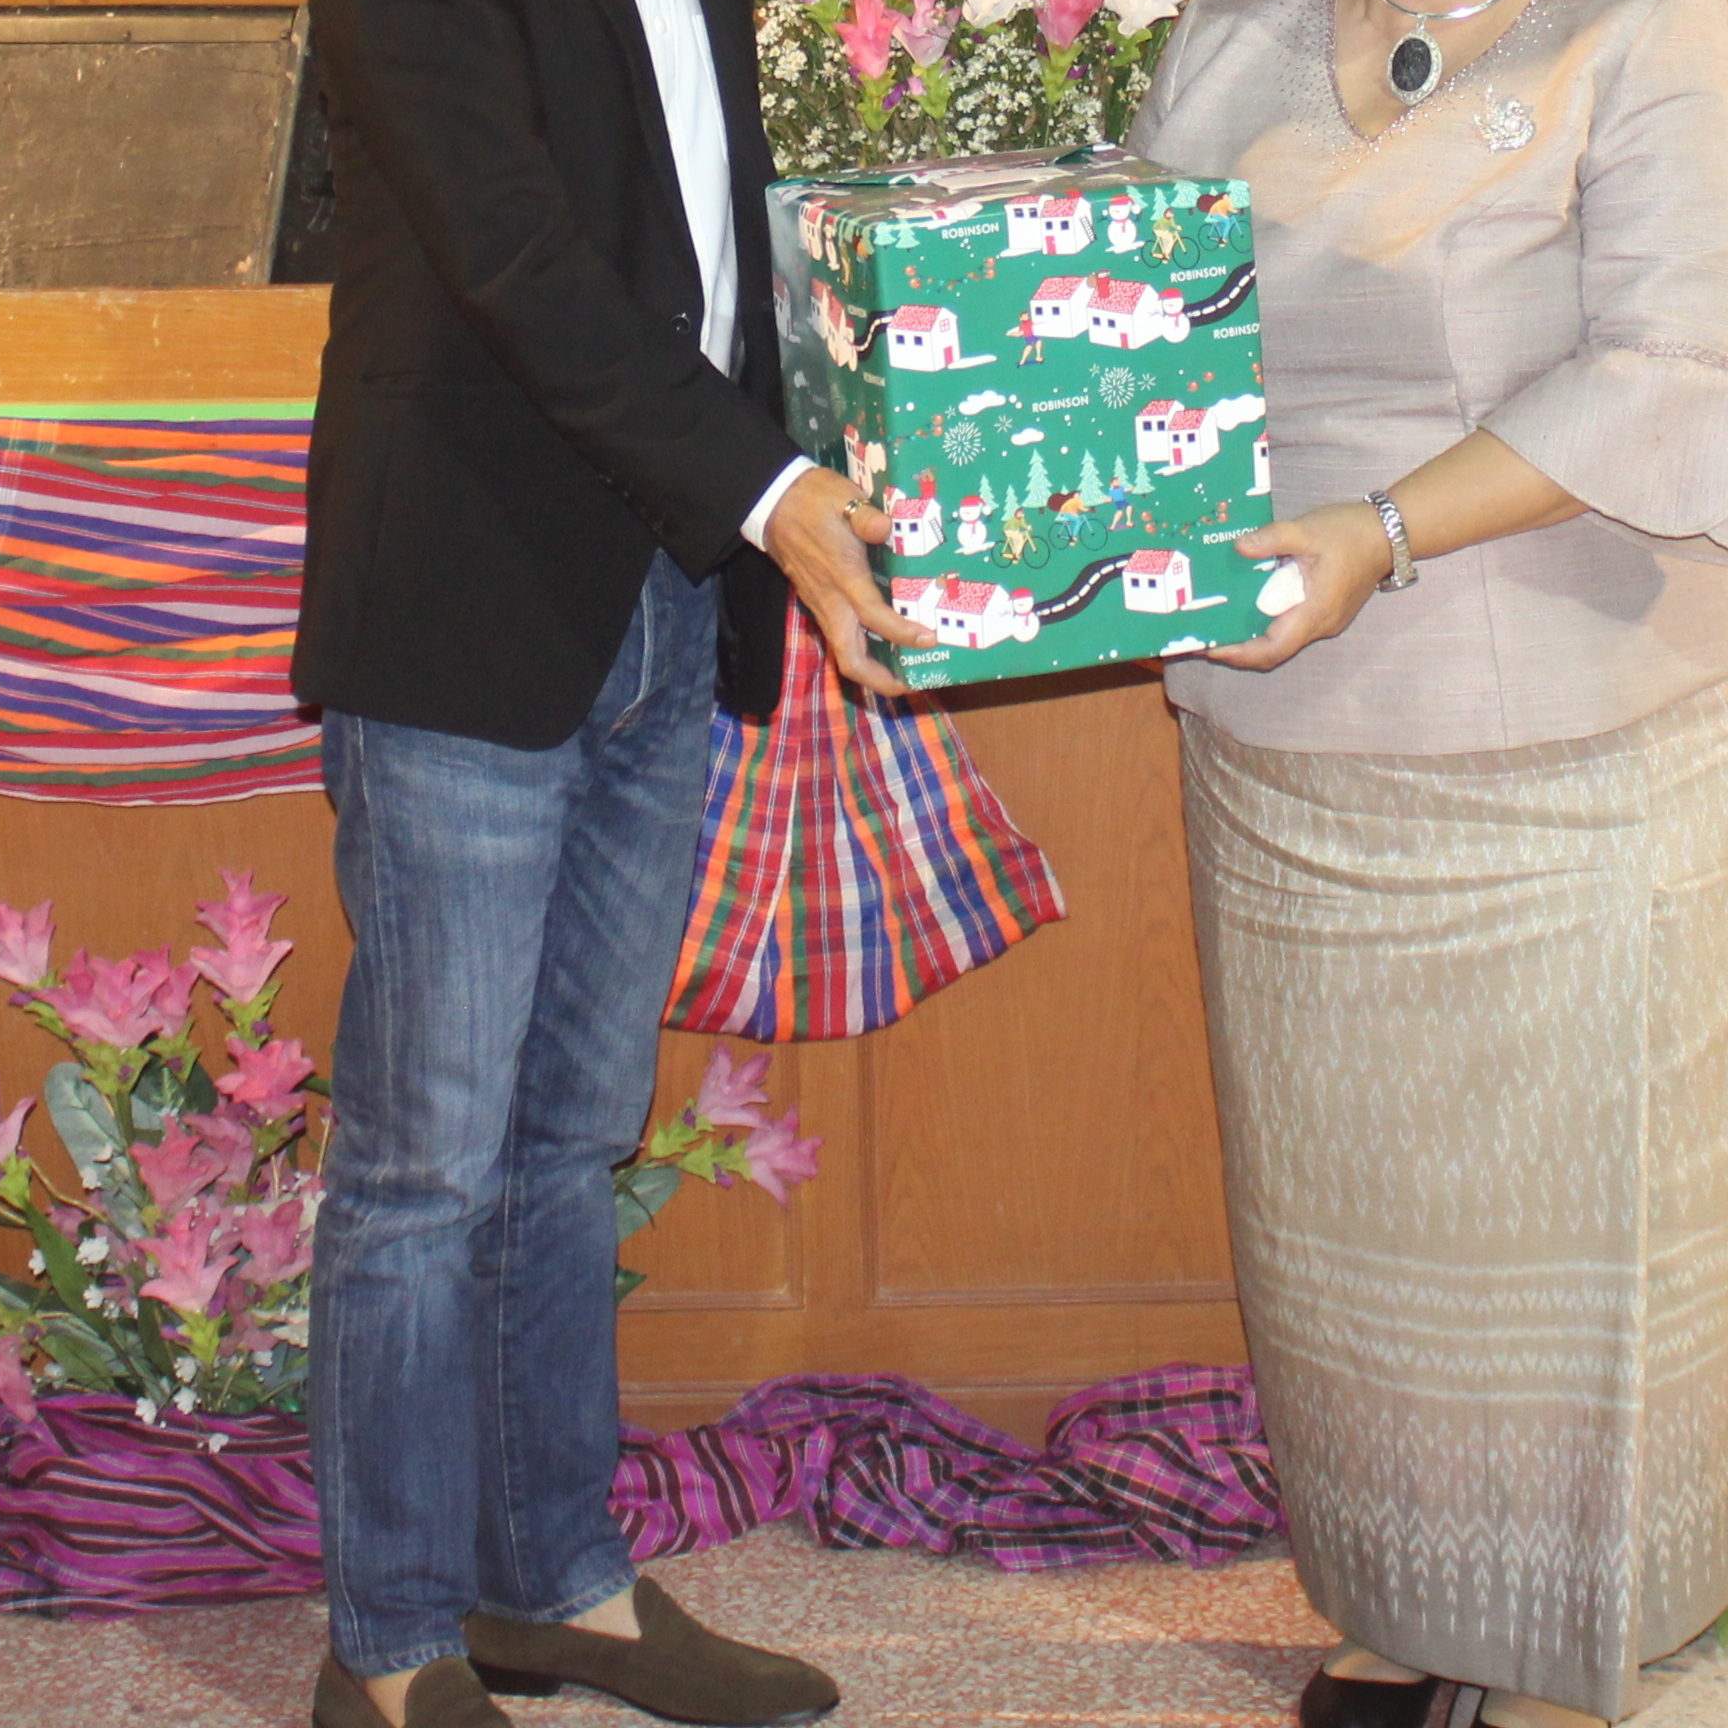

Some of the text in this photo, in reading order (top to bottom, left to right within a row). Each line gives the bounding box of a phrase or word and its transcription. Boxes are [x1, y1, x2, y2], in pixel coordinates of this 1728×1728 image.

[941, 222, 999, 240] ROBINSON
[1170, 265, 1227, 283] ROBINSON
[1032, 395, 1089, 413] ROBINSON
[1203, 526, 1258, 545] ROBINS
